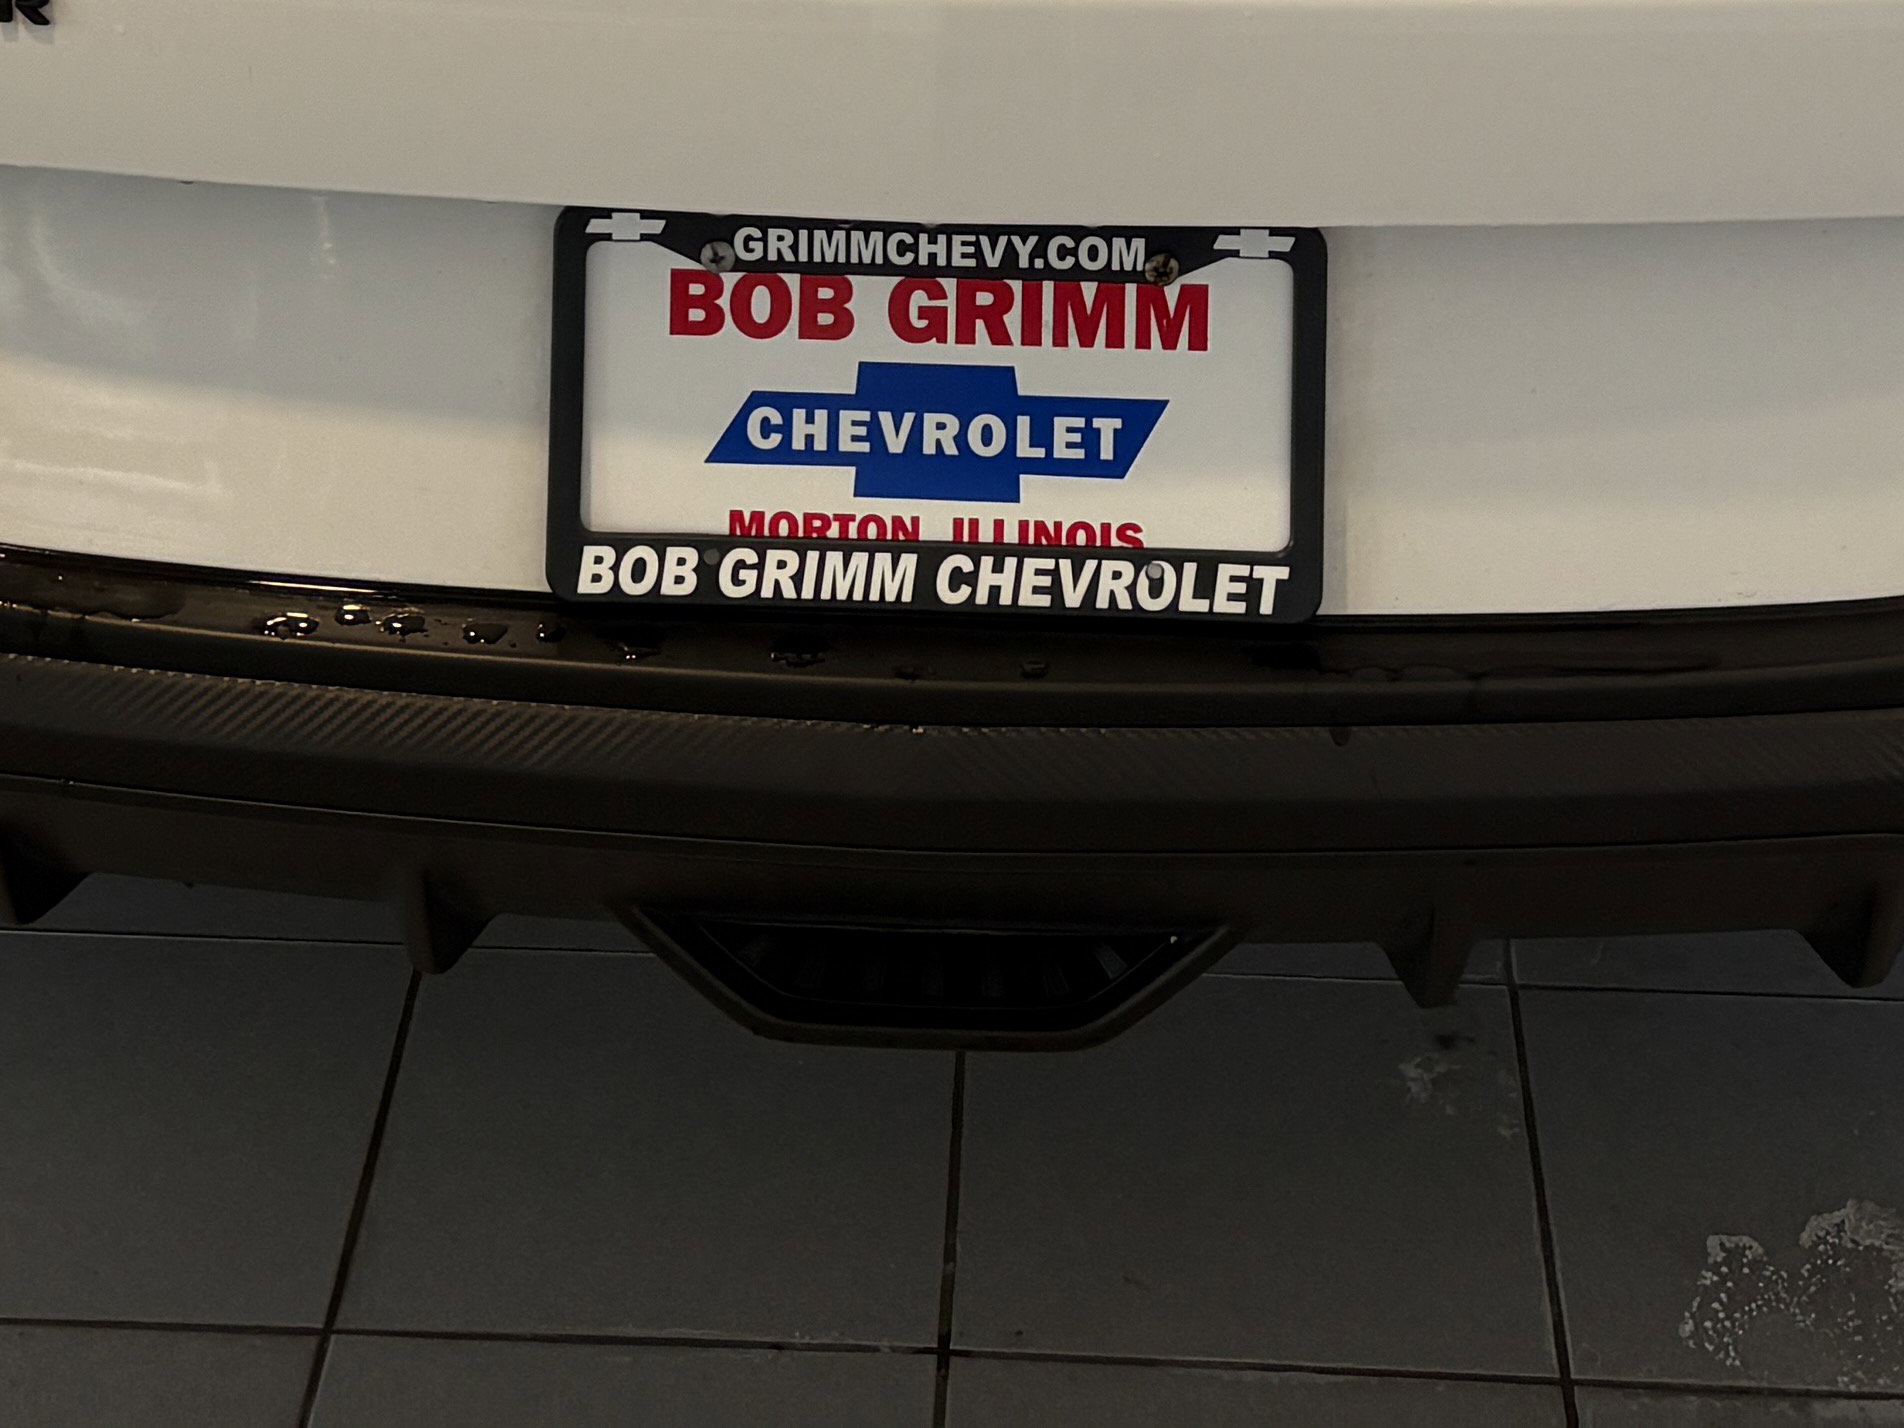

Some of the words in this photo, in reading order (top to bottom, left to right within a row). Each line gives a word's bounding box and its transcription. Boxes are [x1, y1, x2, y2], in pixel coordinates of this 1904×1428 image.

[732, 226, 1147, 272] GRIMMCHEVY.COM
[669, 268, 855, 342] BOB
[888, 278, 1210, 352] GRIMM
[745, 406, 1124, 460] CHEVROLET
[576, 545, 699, 596] BOB
[718, 548, 915, 604] GRIMM
[935, 554, 1290, 615] CHEVROLET
